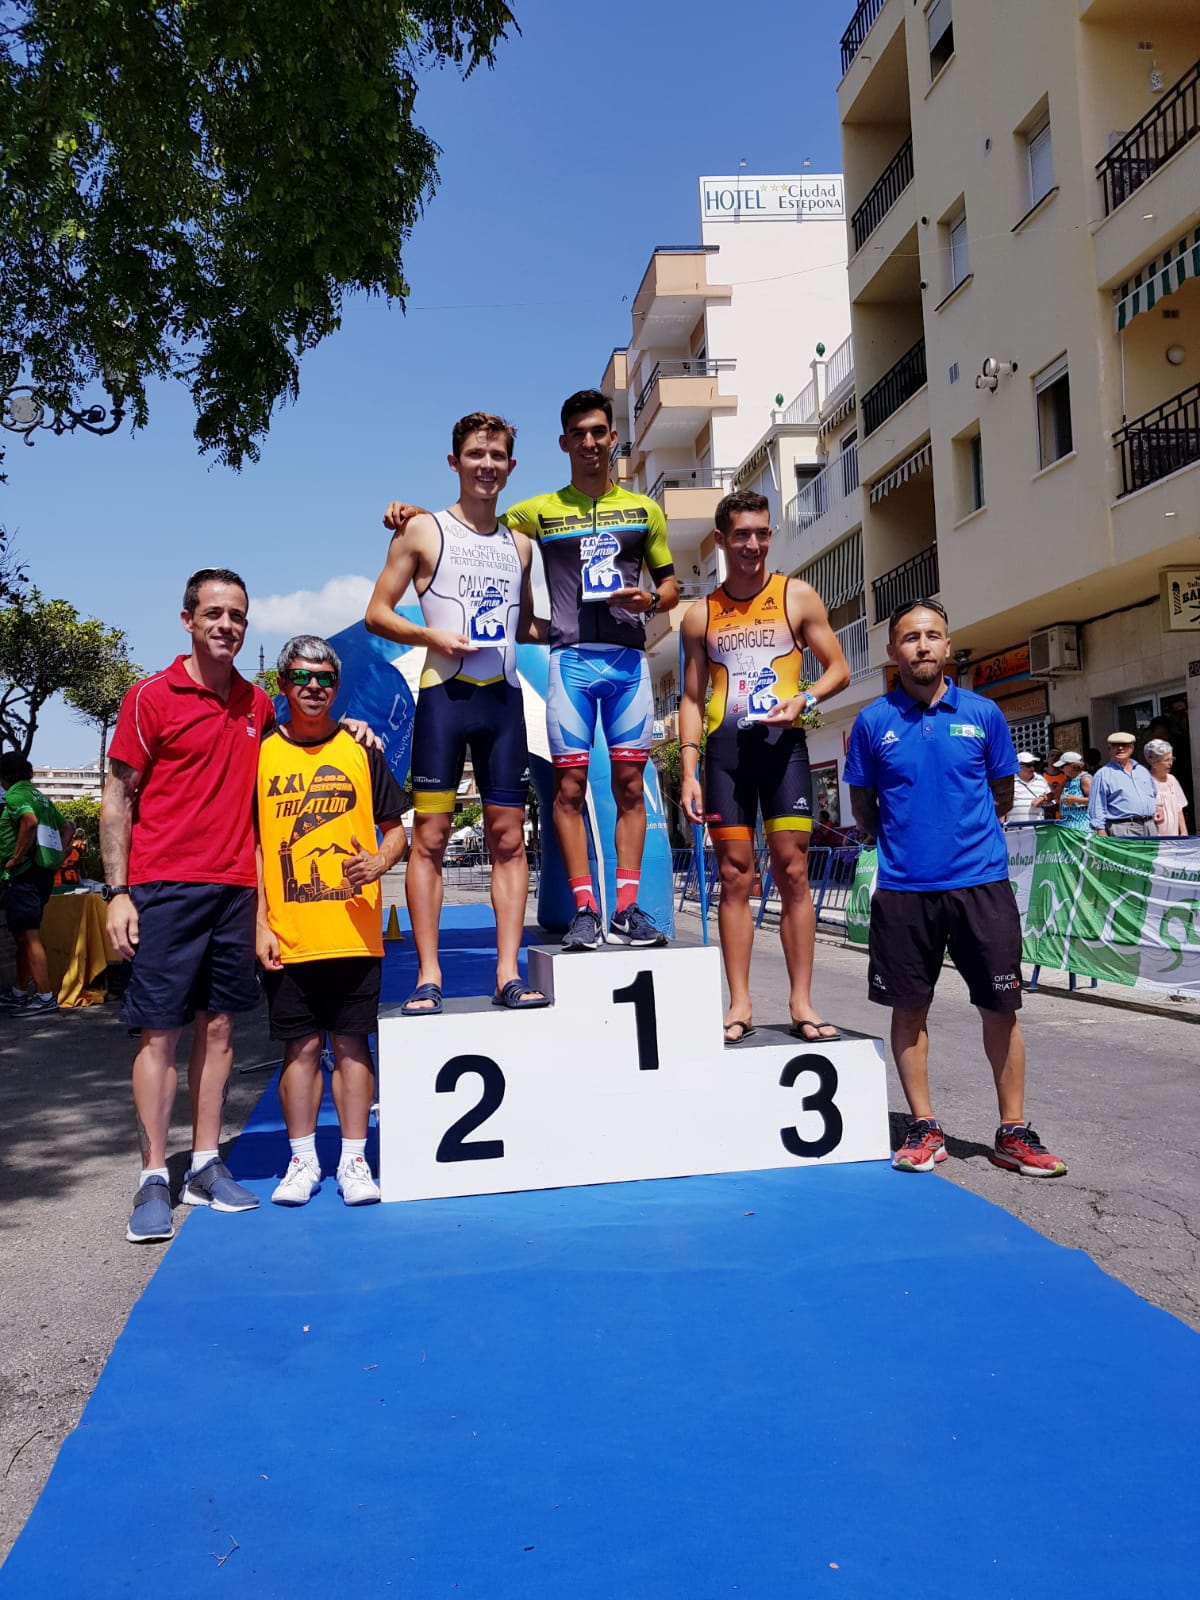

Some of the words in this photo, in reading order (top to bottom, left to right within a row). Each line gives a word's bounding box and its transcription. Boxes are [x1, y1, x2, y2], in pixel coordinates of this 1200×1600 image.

[706, 190, 766, 210] HOTEL
[788, 184, 836, 198] Ciudad
[717, 628, 776, 654] RODRÍGUEZ
[267, 772, 305, 797] XXI
[275, 792, 349, 818] TRIATLÓN
[613, 970, 659, 1071] 1
[435, 1054, 506, 1163] 2
[779, 1053, 843, 1159] 3
